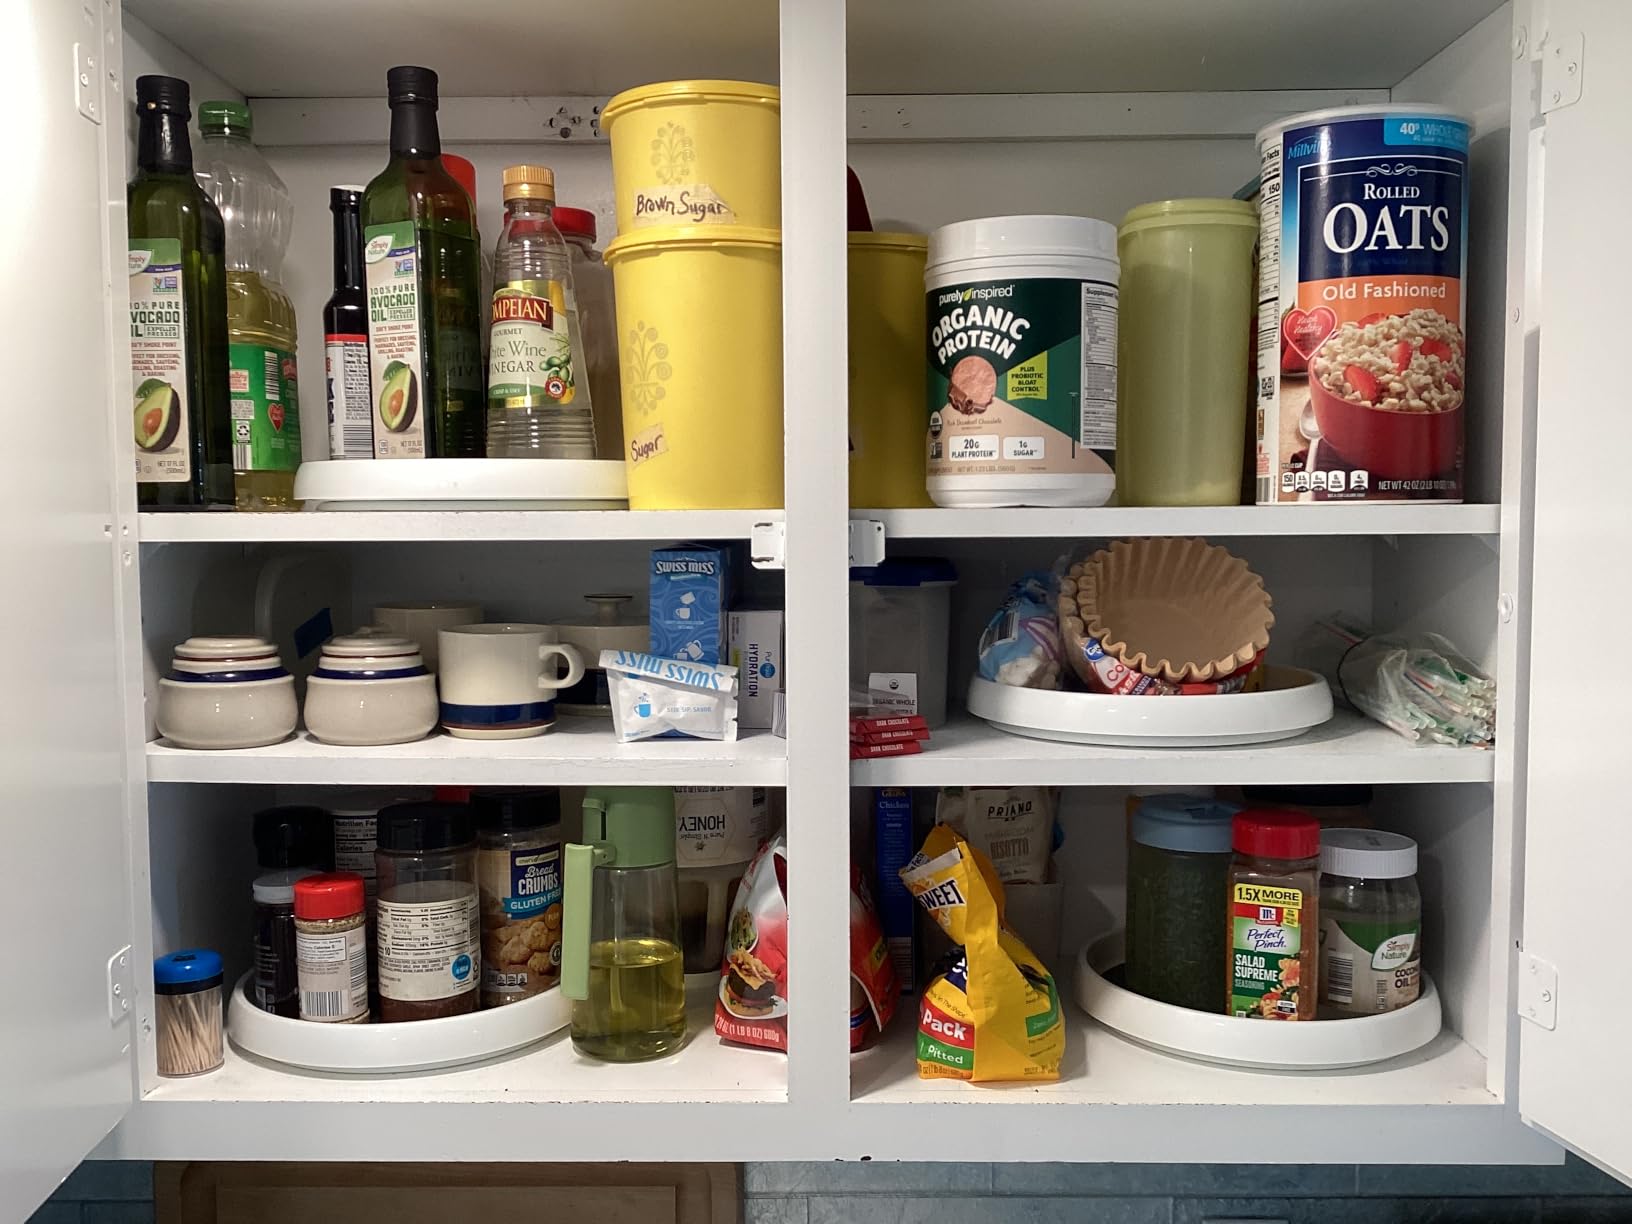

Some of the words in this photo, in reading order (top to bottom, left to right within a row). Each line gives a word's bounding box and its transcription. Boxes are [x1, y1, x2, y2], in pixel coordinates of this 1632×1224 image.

[1269, 182, 1280, 194] 150
[1364, 183, 1420, 200] ROLLED
[637, 194, 675, 216] Brown
[677, 191, 722, 222] Sugar
[1323, 202, 1449, 254] OATS
[370, 285, 391, 296] 100%
[393, 283, 415, 293] PURE
[939, 292, 963, 307] purely
[971, 285, 1014, 301] inspired
[1323, 285, 1356, 301] Old
[1364, 282, 1447, 298] Fashioned
[152, 301, 180, 310] PURE
[371, 293, 415, 309] AVOCADO
[371, 308, 387, 322] OIL
[932, 305, 1031, 348] ORGANIC
[508, 340, 547, 357] Wine
[938, 330, 1016, 365] PROTEIN
[631, 434, 663, 462] Sugar
[951, 450, 967, 458] PLANT
[1378, 480, 1390, 490] NET
[1391, 480, 1401, 490] WT
[1402, 480, 1410, 489] 42
[748, 643, 759, 697] HYDRATION
[888, 718, 910, 726] CHOCOLATE
[882, 744, 904, 752] CHOCOLATE
[988, 801, 1033, 817] PRIANO
[679, 815, 726, 832] HONEY
[990, 838, 1030, 859] RISOTTO
[525, 864, 556, 878] Bread
[518, 873, 558, 896] CRUMBS
[1238, 887, 1261, 902] 1.5X
[1262, 890, 1300, 901] MORE
[511, 897, 547, 910] GLUTEN
[1247, 929, 1284, 941] Perfect
[1235, 954, 1266, 968] SALAD
[1381, 951, 1408, 961] Nature
[1235, 966, 1279, 982] SUPREME
[1394, 977, 1409, 989] OIL
[924, 1008, 971, 1041] Pack
[928, 1044, 963, 1064] Pitted
